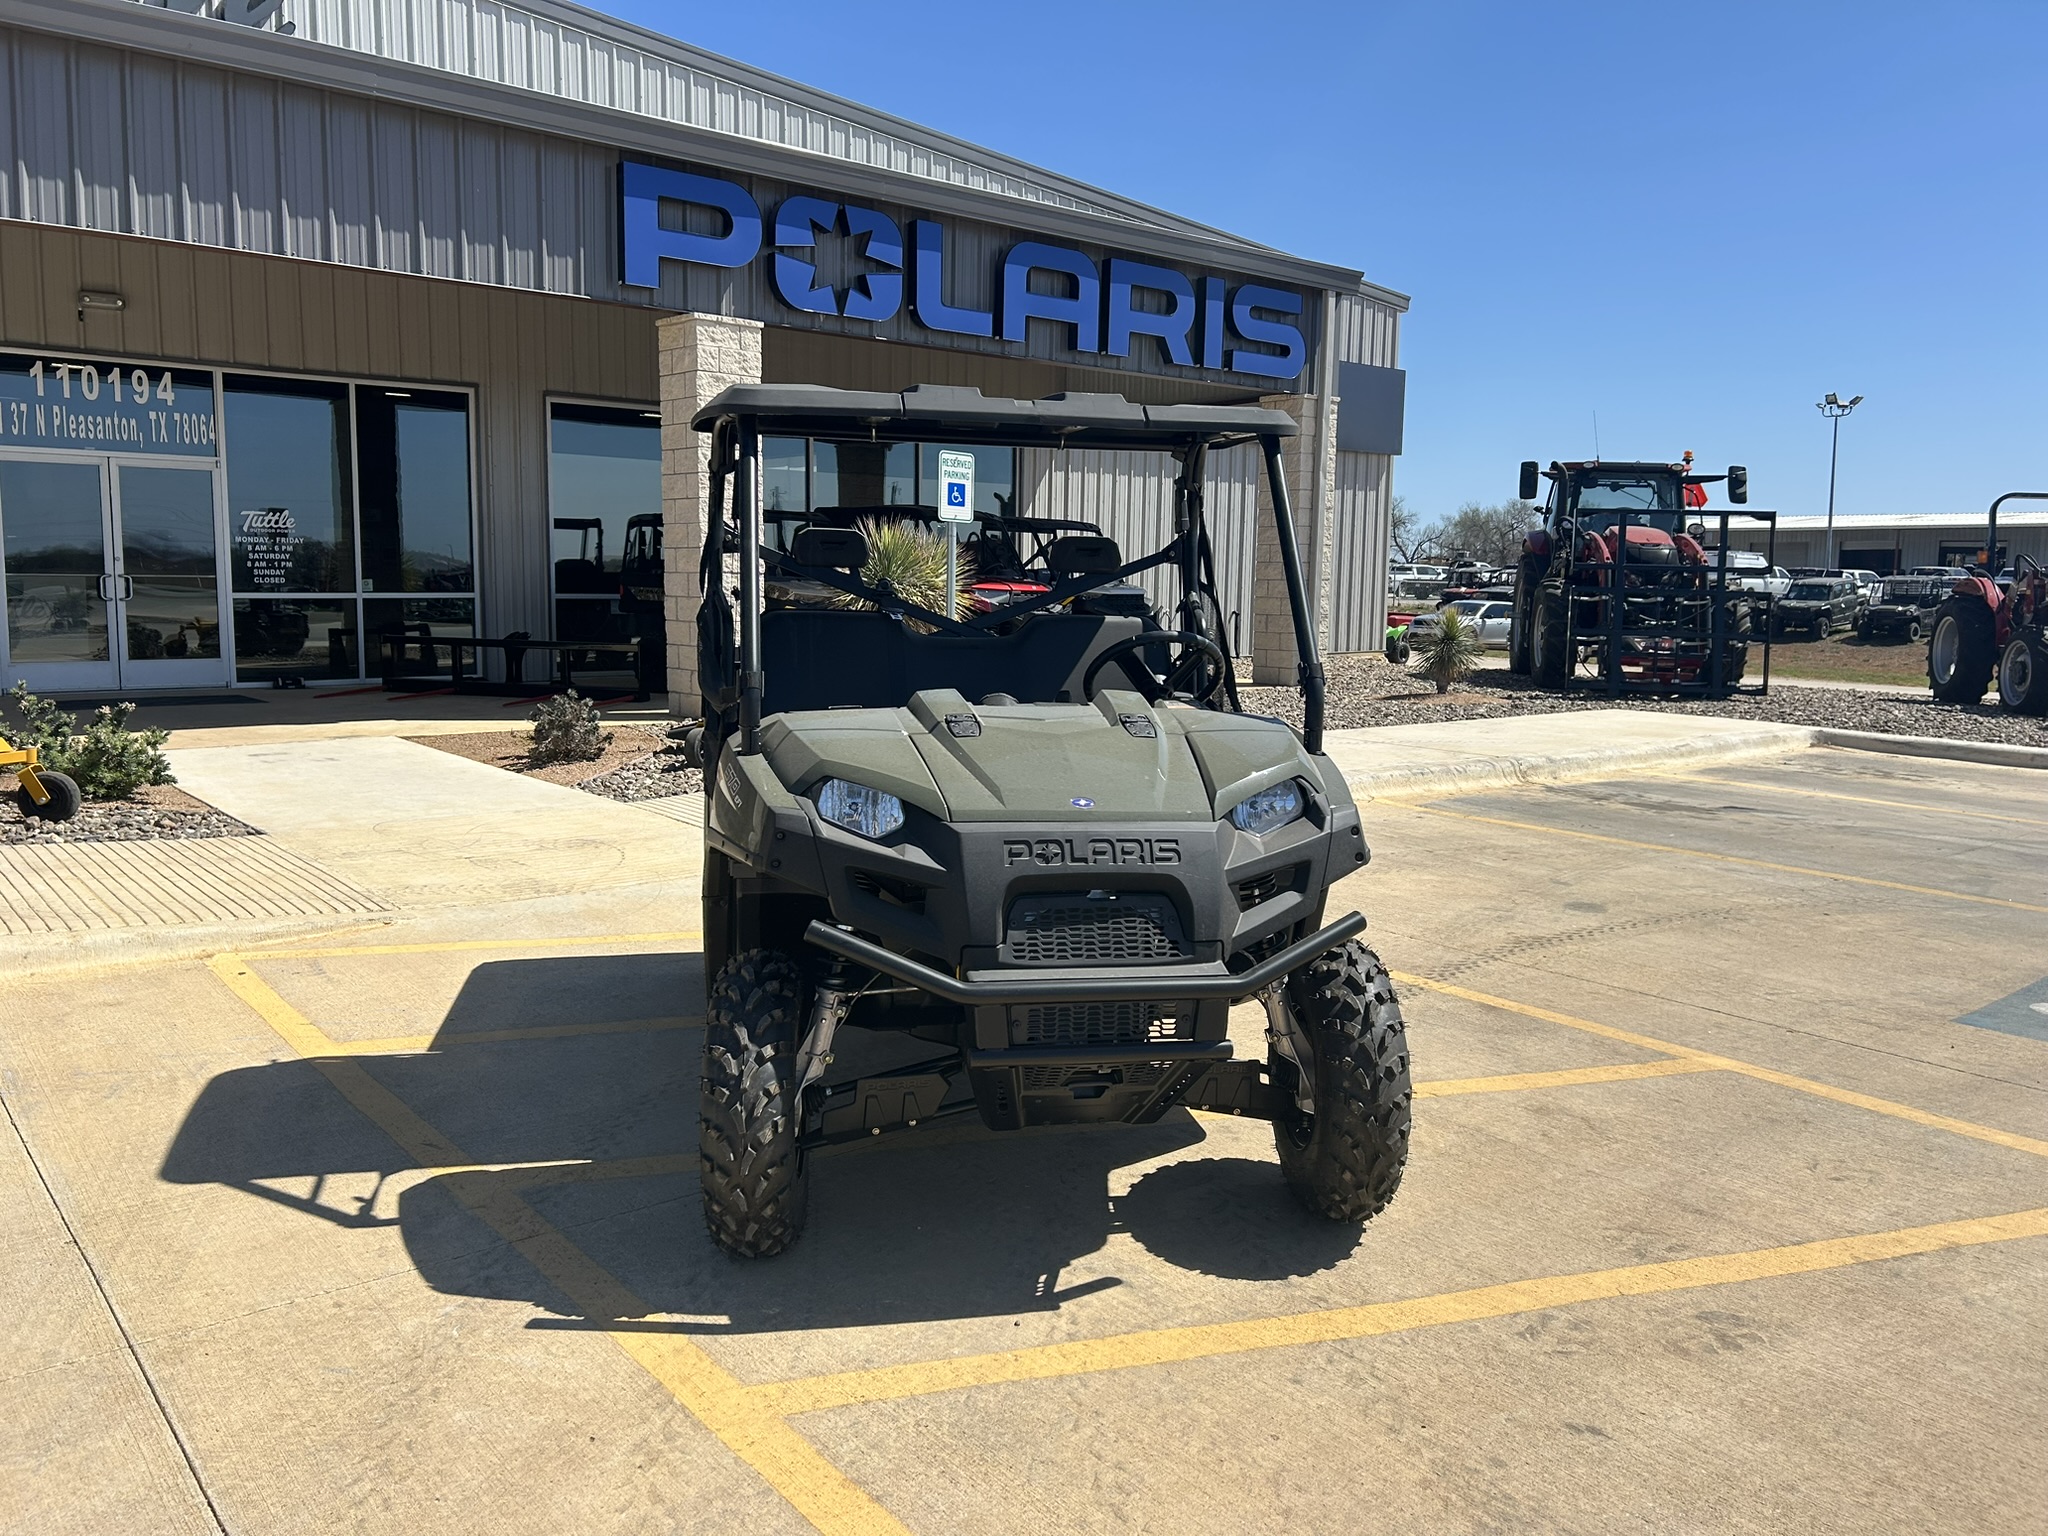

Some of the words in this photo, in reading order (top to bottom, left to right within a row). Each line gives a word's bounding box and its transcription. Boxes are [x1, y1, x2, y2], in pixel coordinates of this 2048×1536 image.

[618, 160, 1306, 379] POLARIS
[29, 360, 175, 406] 110194
[10, 401, 28, 436] 37
[35, 403, 46, 437] N
[52, 404, 144, 449] Pleasanton,
[149, 410, 168, 443] TX
[174, 412, 216, 445] 78064
[942, 457, 972, 470] RESERVED
[943, 469, 970, 481] PARKING
[240, 509, 296, 533] Tuttle
[276, 536, 304, 544] FRIDAY
[248, 552, 290, 560] SATURDAY
[1003, 837, 1182, 867] POLARIS
[865, 1079, 933, 1092] POLARIS
